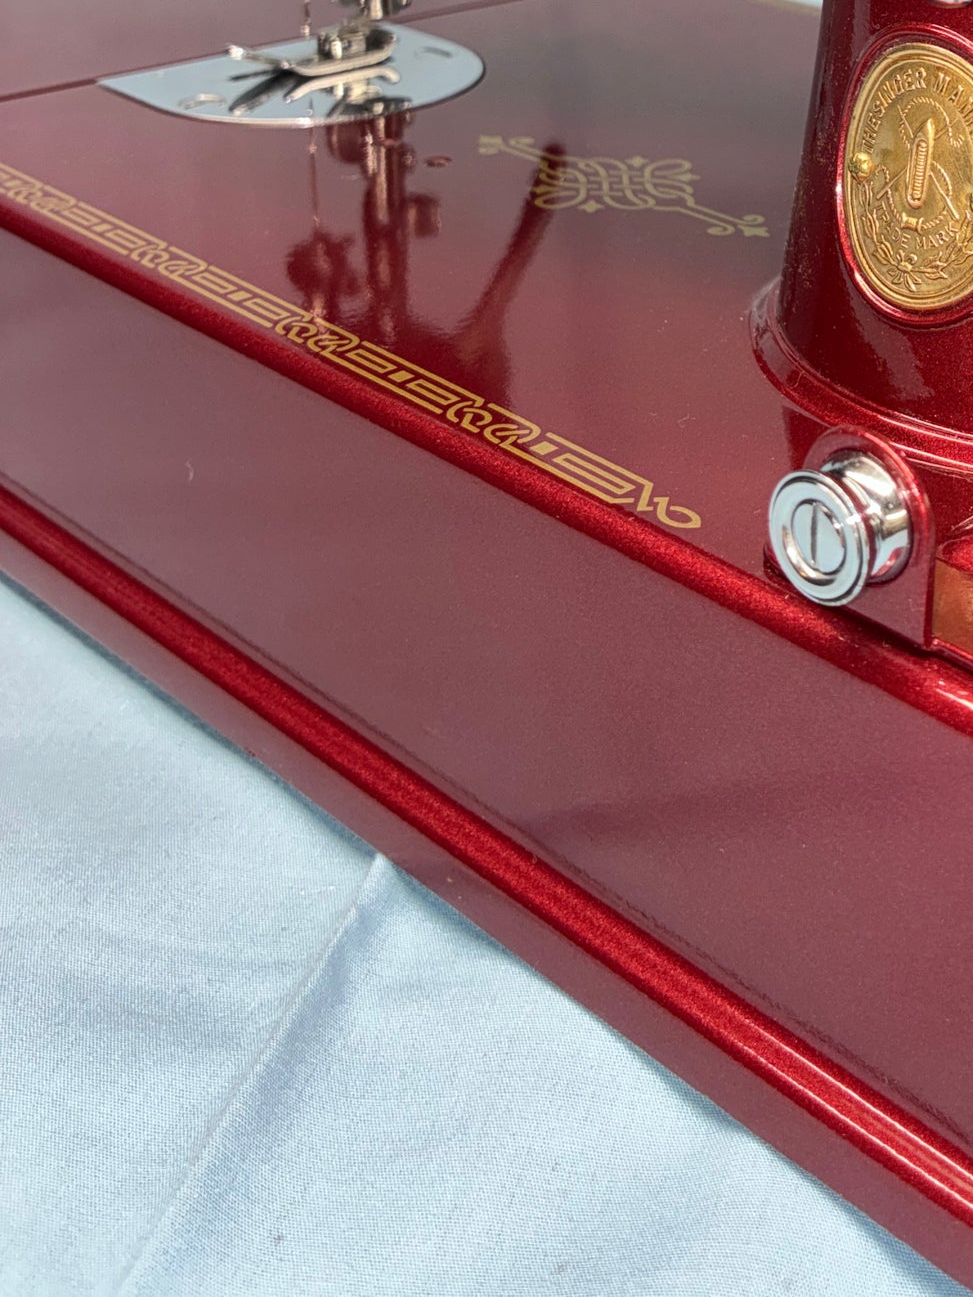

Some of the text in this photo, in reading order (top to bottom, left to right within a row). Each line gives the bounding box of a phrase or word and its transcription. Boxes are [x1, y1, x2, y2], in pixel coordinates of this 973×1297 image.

[862, 113, 881, 153] THE
[873, 67, 927, 117] SINGER
[877, 201, 959, 250] TRADE MARK
